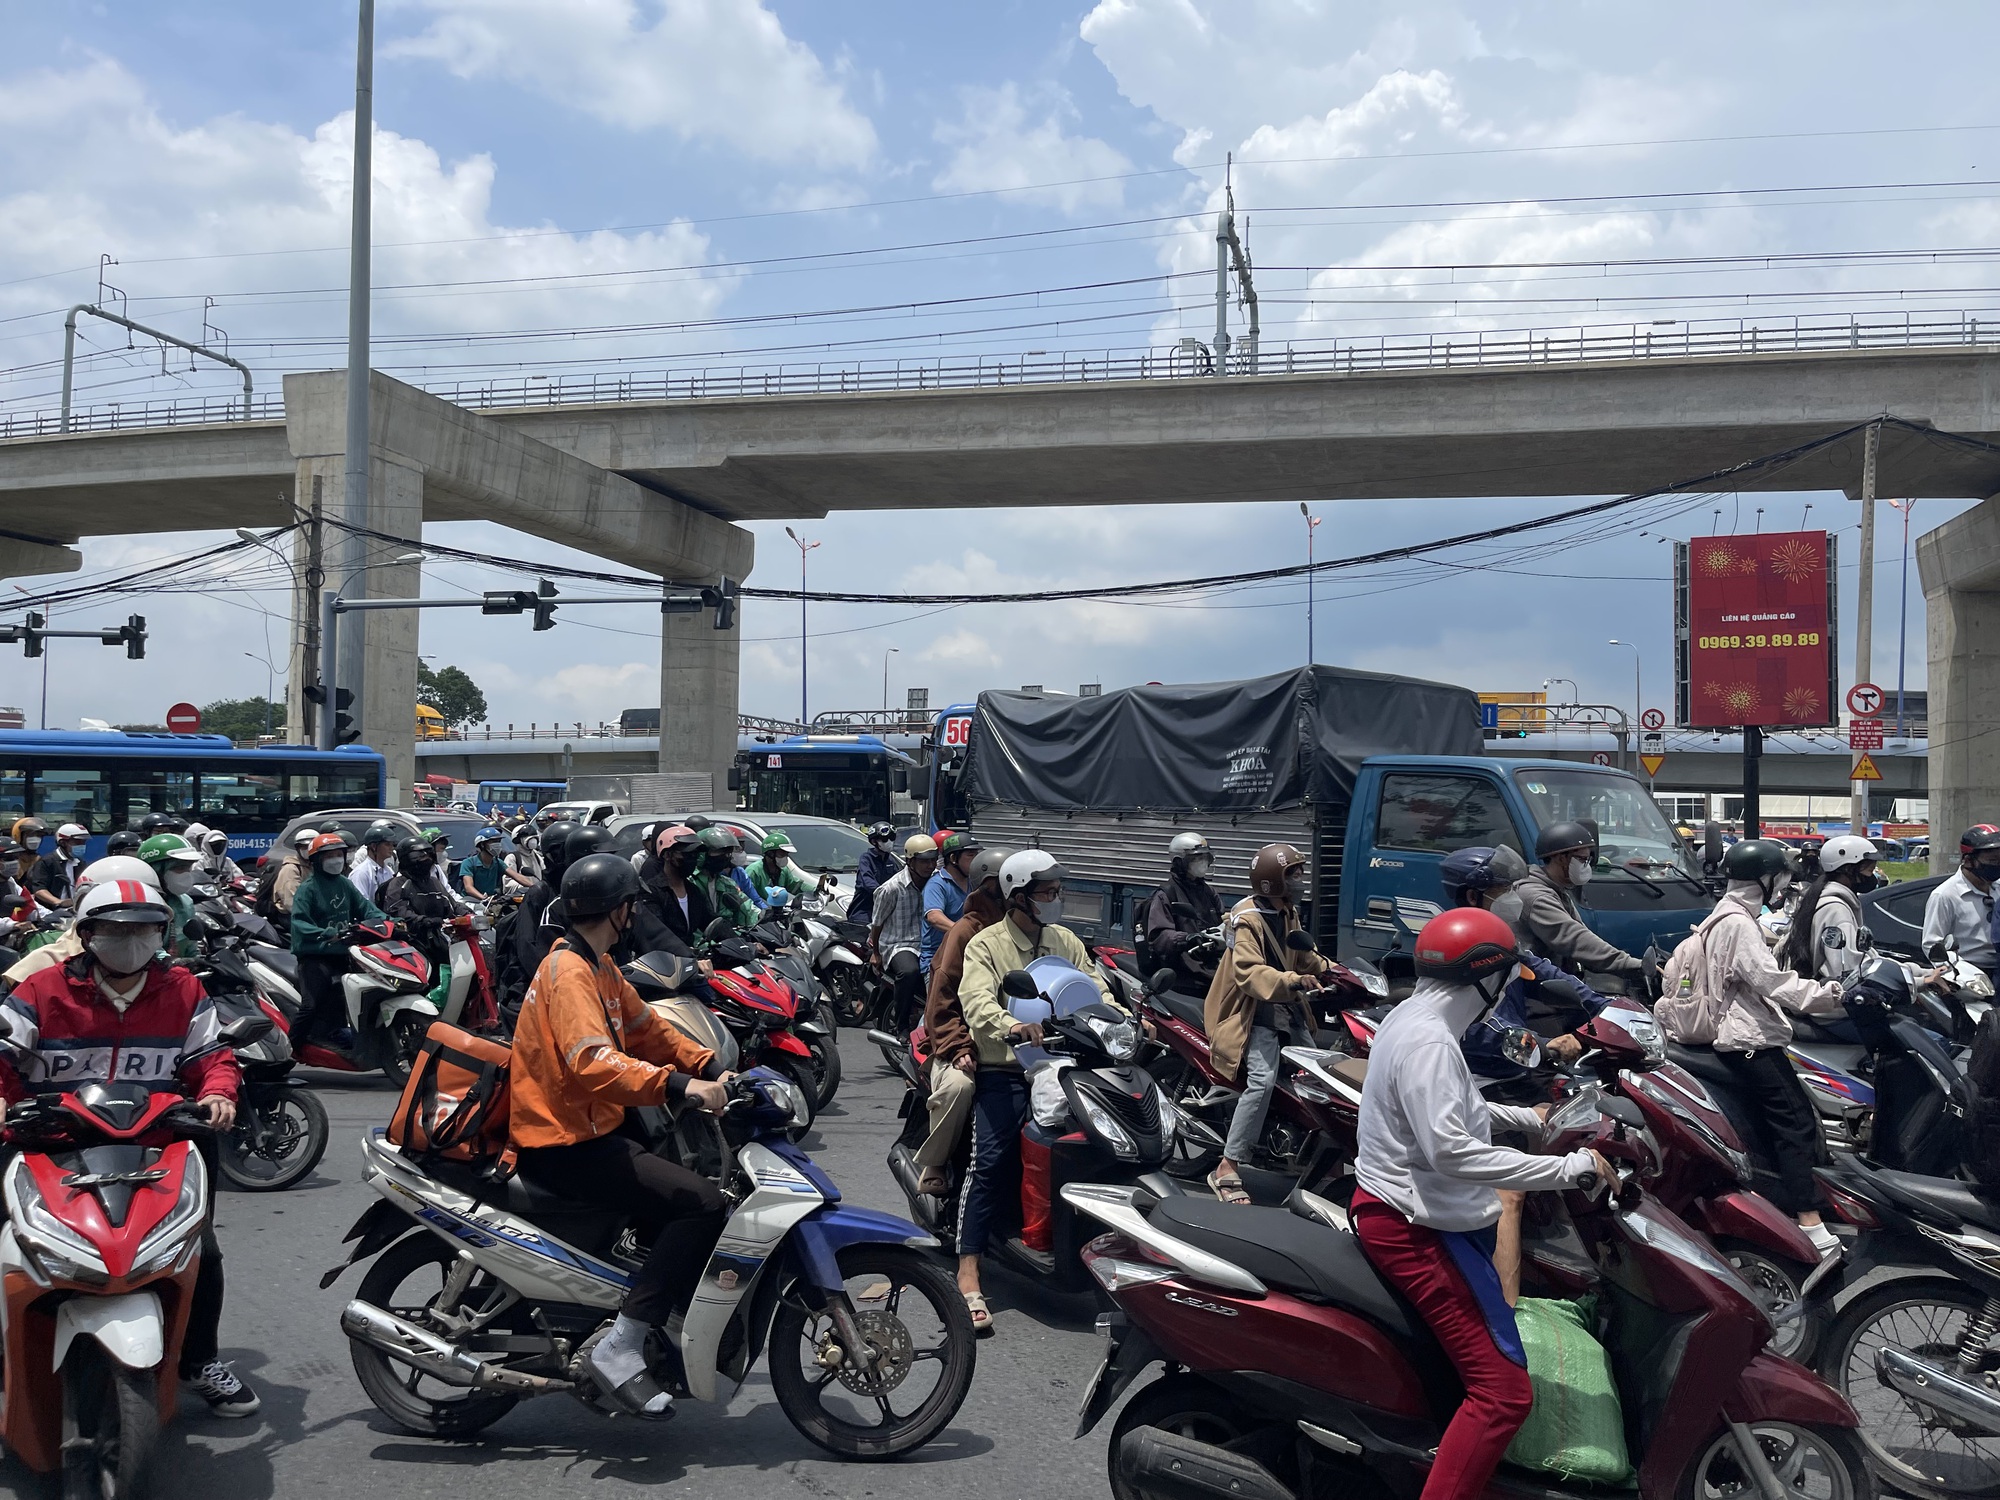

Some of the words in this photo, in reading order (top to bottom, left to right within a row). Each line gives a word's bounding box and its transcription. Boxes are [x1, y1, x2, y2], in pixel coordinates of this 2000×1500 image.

[1721, 613, 1739, 622] LIÊN
[1740, 613, 1750, 622] HỆ
[1752, 612, 1778, 621] QUẢNG
[1780, 612, 1796, 620] CÁO
[1699, 633, 1819, 649] 0969.39.89.89
[947, 719, 971, 744] 56
[769, 757, 780, 766] 141
[1230, 757, 1267, 773] KHOA
[141, 849, 160, 860] Grab
[51, 1053, 183, 1077] PRI
